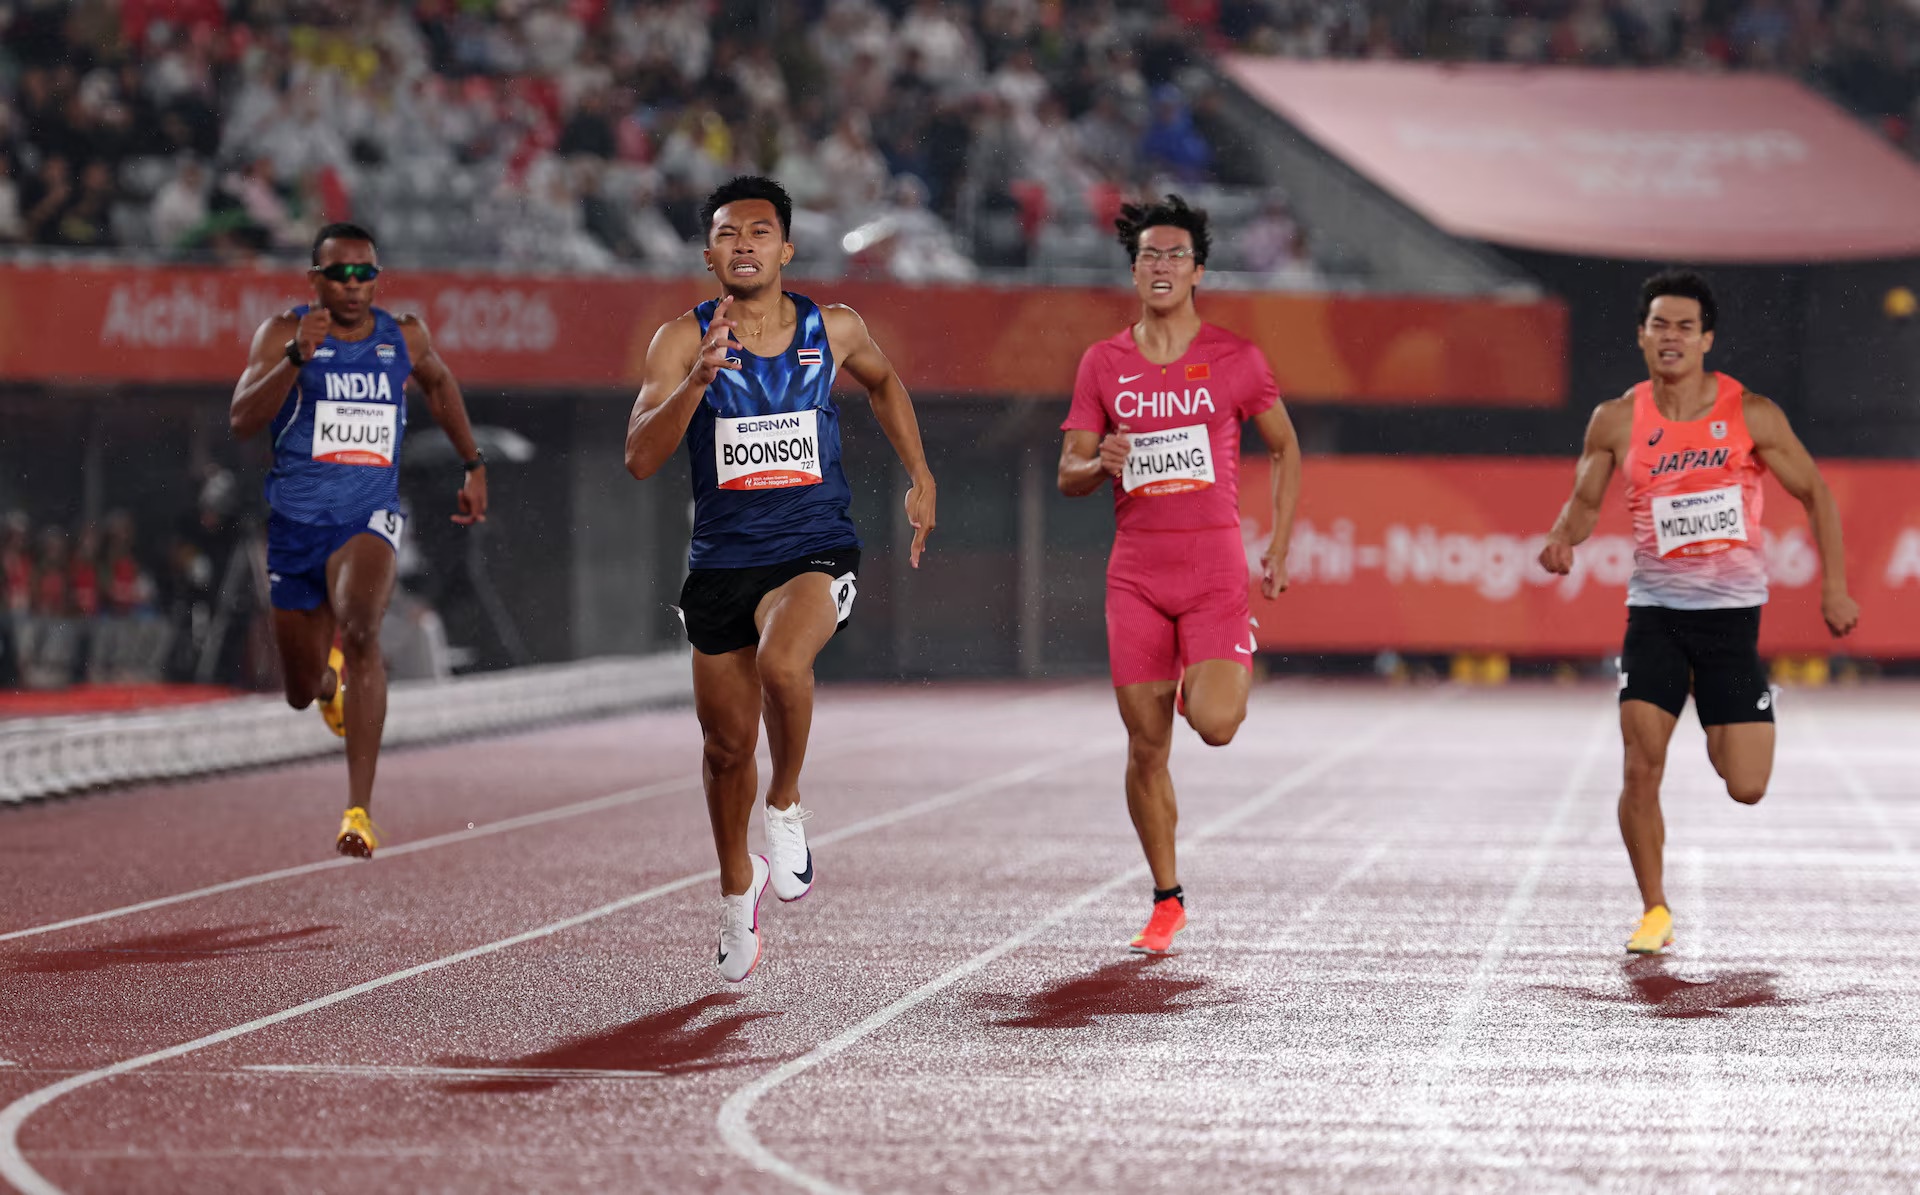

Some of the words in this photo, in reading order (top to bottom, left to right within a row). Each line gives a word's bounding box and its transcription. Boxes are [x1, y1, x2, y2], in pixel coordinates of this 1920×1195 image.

[438, 288, 558, 350] 2026
[325, 372, 392, 400] INDIA
[1114, 387, 1216, 418] CHINA
[321, 423, 390, 444] KUJUR
[736, 417, 800, 434] BORNAN
[1134, 432, 1189, 447] BORNAN
[723, 436, 814, 466] BOONSON
[801, 460, 815, 470] 727
[1126, 448, 1205, 476] Y.HUANG
[1650, 448, 1729, 476] JAPAN
[1661, 508, 1738, 538] MIZUKUBO
